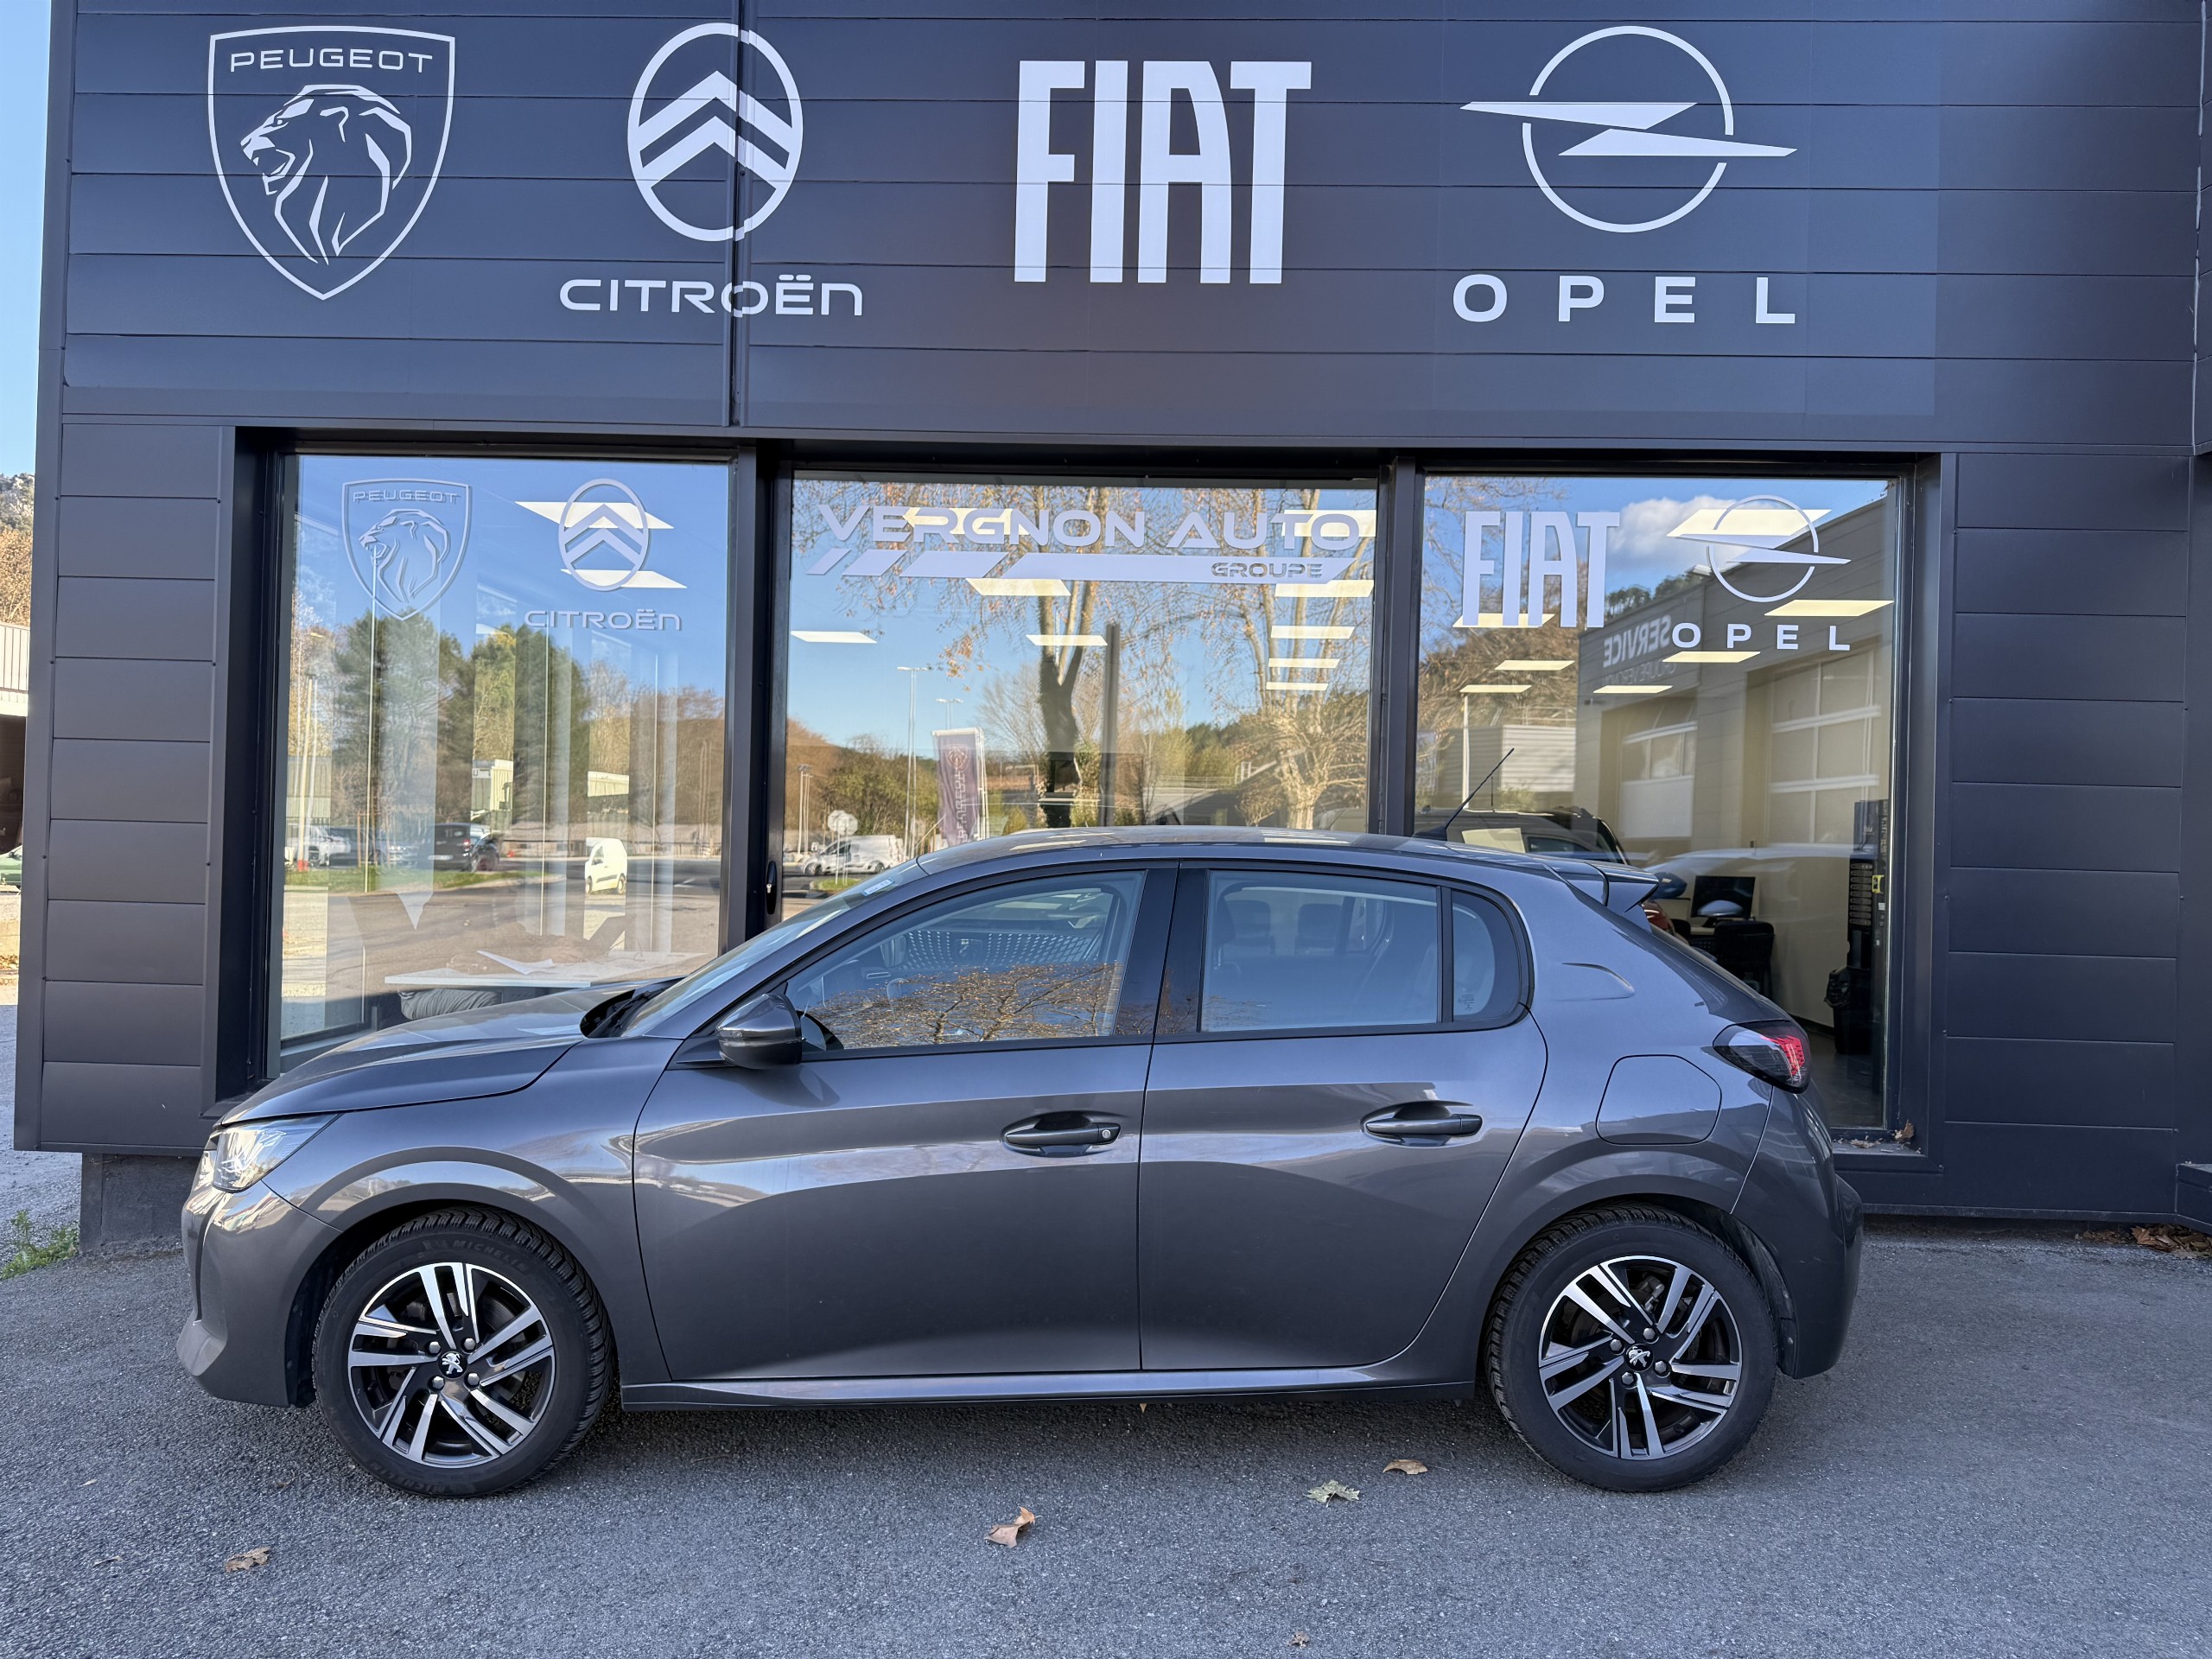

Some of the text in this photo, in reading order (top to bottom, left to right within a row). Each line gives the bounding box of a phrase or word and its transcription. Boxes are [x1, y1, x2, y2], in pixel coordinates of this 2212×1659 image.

[229, 48, 433, 73] PEUGEOT
[1014, 60, 1312, 284] FIAT
[560, 275, 862, 318] CITROËN
[1452, 274, 1796, 324] OPEL
[353, 491, 461, 504] PEUGEOT
[817, 504, 1361, 551] VERGNON AUTO
[1210, 562, 1323, 579] GROUPE
[1462, 511, 1620, 628] FIAT
[524, 609, 682, 631] CITROËN
[1671, 622, 1851, 652] OPEL
[452, 1240, 530, 1272] MICHELIN
